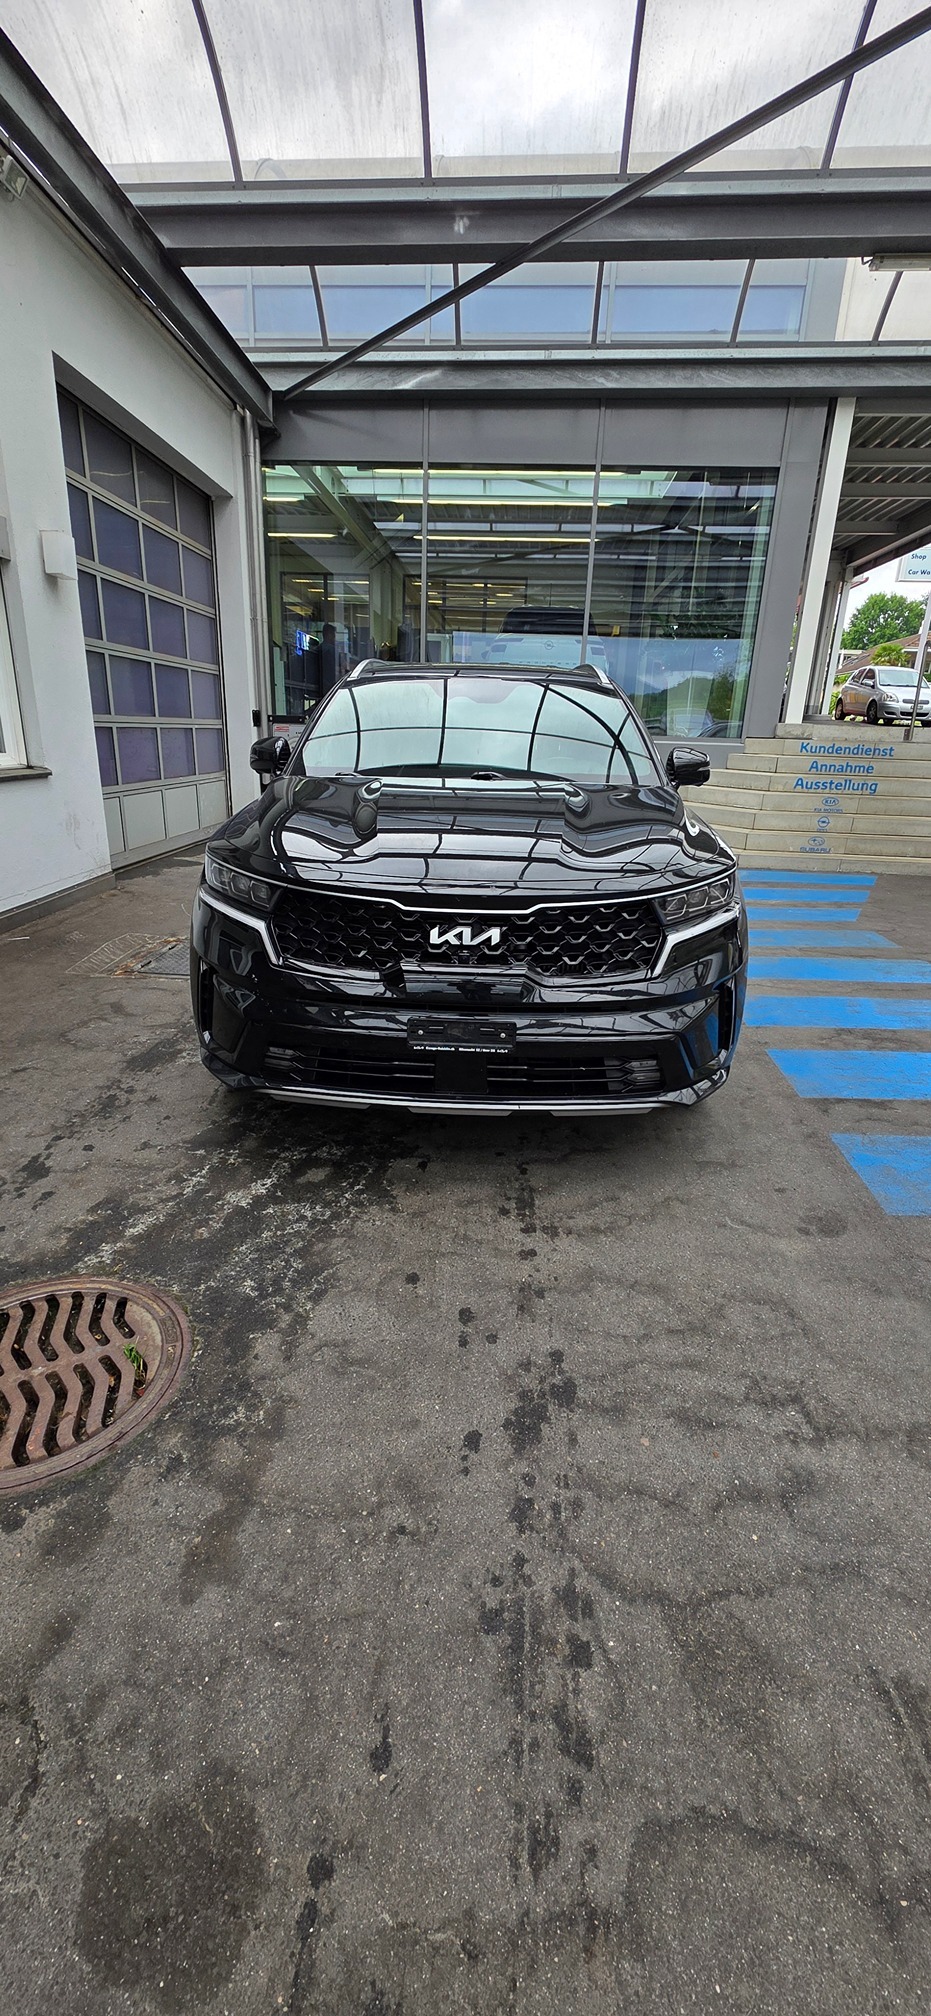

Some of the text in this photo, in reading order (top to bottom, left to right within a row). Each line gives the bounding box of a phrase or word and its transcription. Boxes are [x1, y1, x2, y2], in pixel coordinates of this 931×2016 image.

[911, 553, 927, 561] Shop
[799, 742, 895, 757] Kundendienst
[808, 760, 875, 774] Annahme
[793, 777, 879, 795] Ausstellung
[429, 925, 501, 946] KIA
